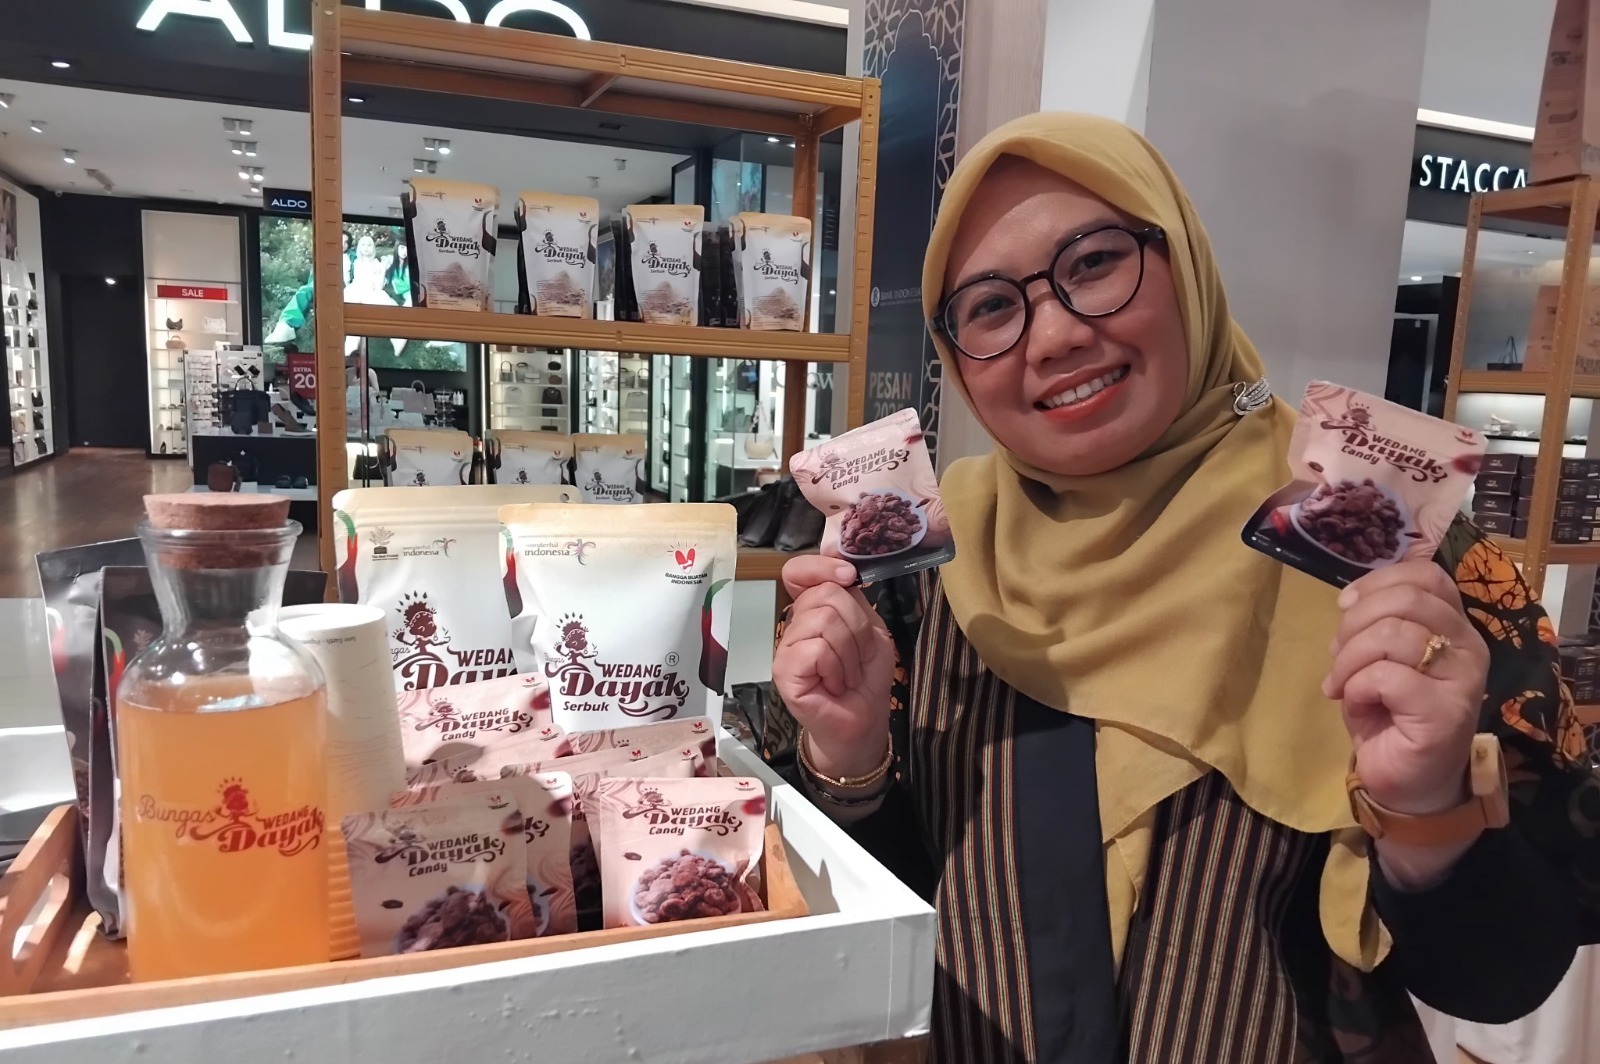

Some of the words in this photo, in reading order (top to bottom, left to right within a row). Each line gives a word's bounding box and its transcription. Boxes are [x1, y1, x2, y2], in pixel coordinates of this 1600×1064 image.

[271, 198, 307, 209] ALDO
[435, 239, 480, 256] Dayak
[543, 248, 586, 265] Dayak
[648, 259, 691, 274] Dayak
[762, 266, 799, 281] Dayak
[181, 288, 204, 298] SALE
[869, 372, 912, 400] PESAN
[1372, 433, 1427, 458] WEDANG
[846, 448, 886, 468] WEDANG
[1341, 445, 1380, 465] Candy
[1343, 431, 1447, 481] Dayak
[826, 448, 909, 482] Dayak
[832, 475, 859, 490] Candy
[592, 487, 634, 500] Dayak
[403, 549, 439, 557] indonesia
[524, 547, 570, 556] indonesia
[601, 664, 662, 678] WEDANG
[559, 667, 690, 713] Dayak
[461, 708, 509, 722] WEDANG
[563, 701, 610, 712] Serbuk
[435, 710, 533, 733] Dayak
[442, 730, 476, 741] Candy
[138, 794, 217, 839] Bungas
[262, 805, 310, 831] WEDANG
[671, 805, 721, 816] WEDANG
[217, 807, 325, 856] Dayak
[644, 811, 742, 835] Dayak
[649, 826, 685, 836] Candy
[427, 833, 479, 851] WEDANG
[400, 836, 505, 866] Dayak
[409, 862, 448, 877] Candy
